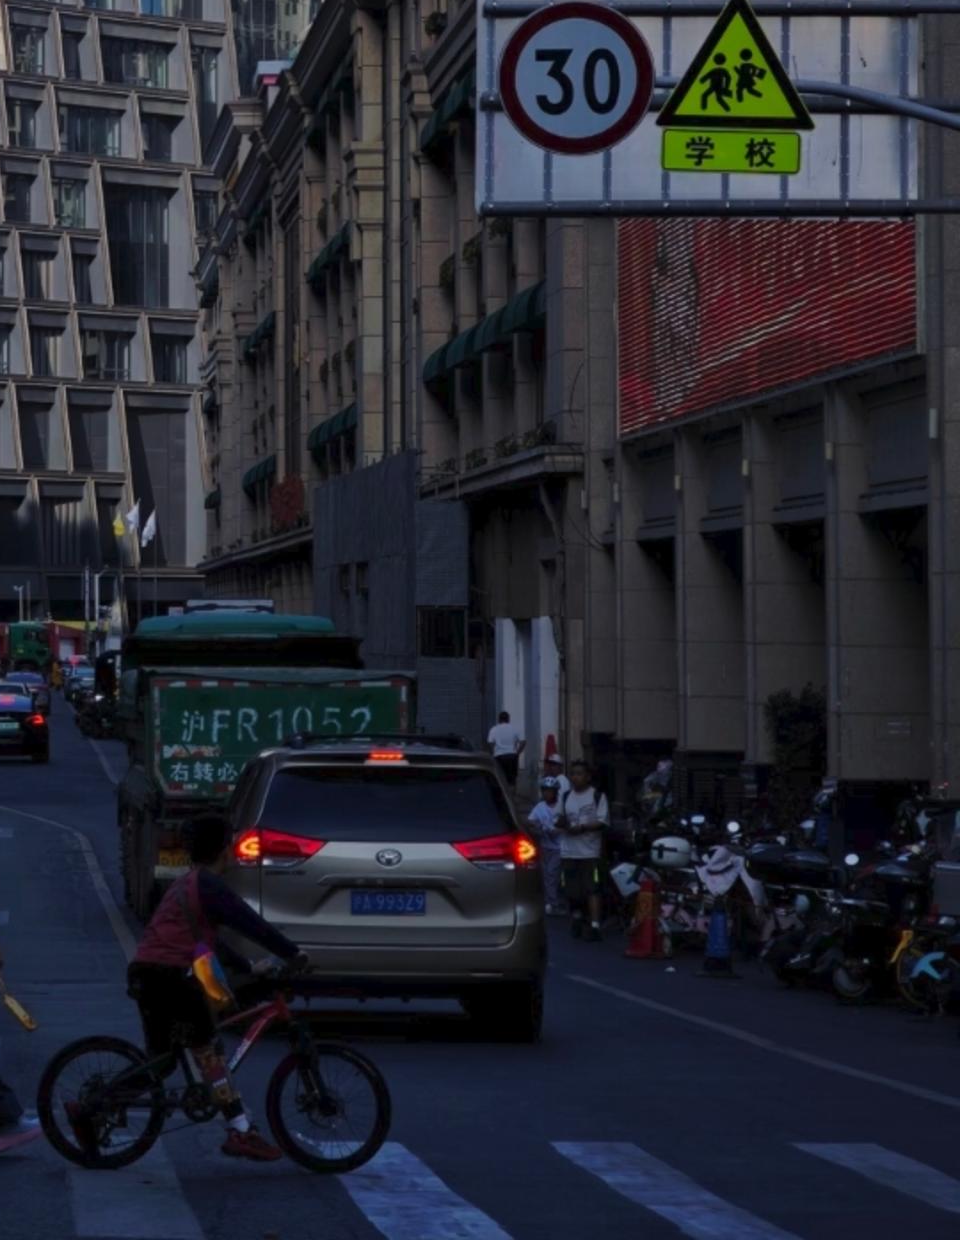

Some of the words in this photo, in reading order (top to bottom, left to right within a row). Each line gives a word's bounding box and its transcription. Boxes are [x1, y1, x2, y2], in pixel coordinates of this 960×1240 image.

[535, 48, 620, 115] 30
[170, 761, 248, 783] 右转必
